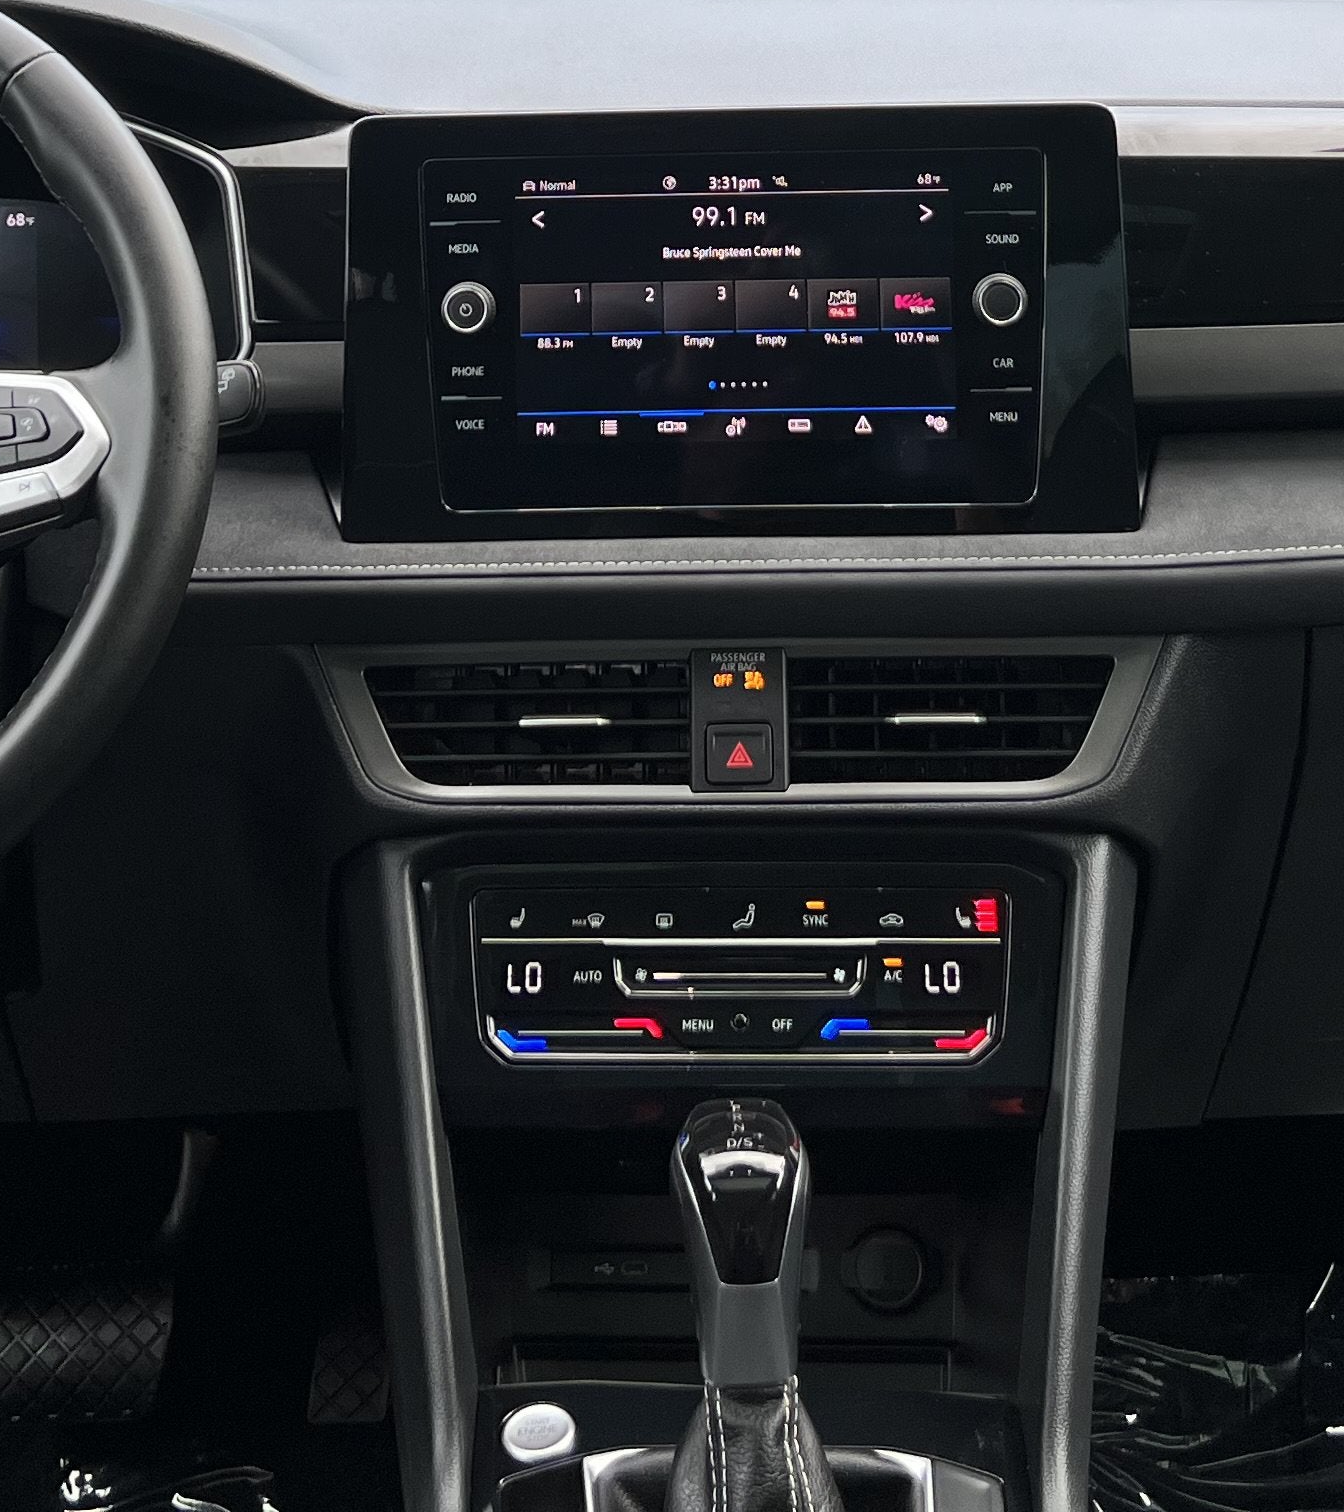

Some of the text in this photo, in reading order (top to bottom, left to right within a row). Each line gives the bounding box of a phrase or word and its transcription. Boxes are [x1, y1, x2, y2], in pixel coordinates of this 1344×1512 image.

[539, 180, 576, 191] Normal
[708, 176, 760, 191] 3:31pm
[992, 182, 1013, 193] APP
[446, 193, 478, 204] RADIO
[692, 206, 766, 227] 99.1 FM
[985, 233, 1020, 244] SOUND
[448, 243, 479, 254] MEDIA
[662, 245, 802, 260] Bruce Springsteen Cover Me
[574, 288, 581, 303] 1
[645, 287, 655, 302] 2
[717, 286, 727, 301] 3
[788, 284, 799, 300] 4
[537, 338, 573, 349] 88.3 FM
[611, 336, 643, 350] Empty
[683, 335, 715, 349] Empty
[756, 334, 787, 348] Empty
[824, 332, 848, 344] 94.5
[894, 332, 924, 344] 107.9
[992, 357, 1014, 368] CAR
[451, 366, 485, 376] PHONE
[989, 411, 1018, 422] MENU
[455, 419, 485, 430] VOICE
[536, 422, 555, 436] FM
[710, 652, 766, 663] PASSENGER
[720, 662, 757, 671] AIR BAG
[713, 673, 734, 688] OFF
[802, 914, 829, 926] SYNC
[506, 961, 543, 995] LO
[573, 971, 603, 984] AUTO
[883, 969, 903, 982] A/C
[923, 960, 962, 995] LO
[681, 1018, 715, 1031] MENU
[771, 1018, 793, 1031] OFF
[726, 1137, 754, 1149] D/S
